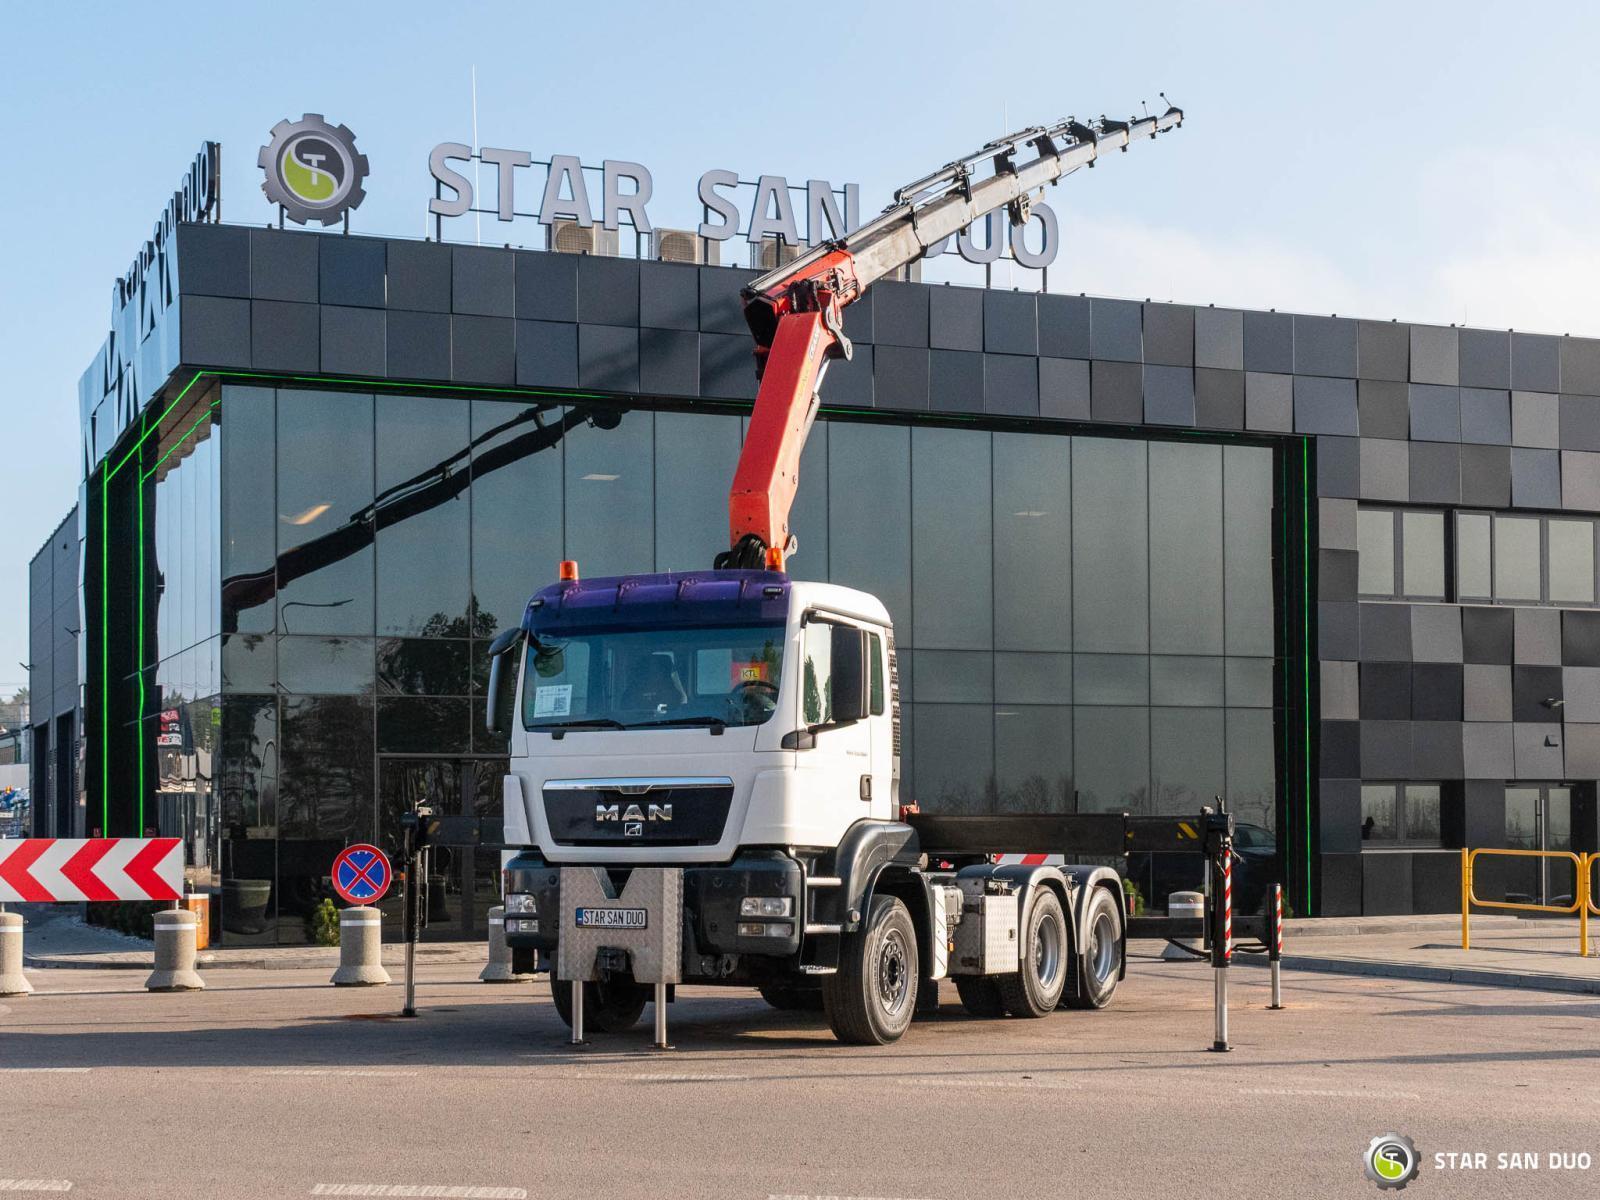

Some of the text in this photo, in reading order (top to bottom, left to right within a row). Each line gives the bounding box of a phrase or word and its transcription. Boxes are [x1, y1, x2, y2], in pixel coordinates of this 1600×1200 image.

[429, 142, 652, 233] STAR
[698, 169, 859, 248] SAN
[596, 804, 673, 821] MAN
[584, 911, 644, 925] STAR SAN DUO
